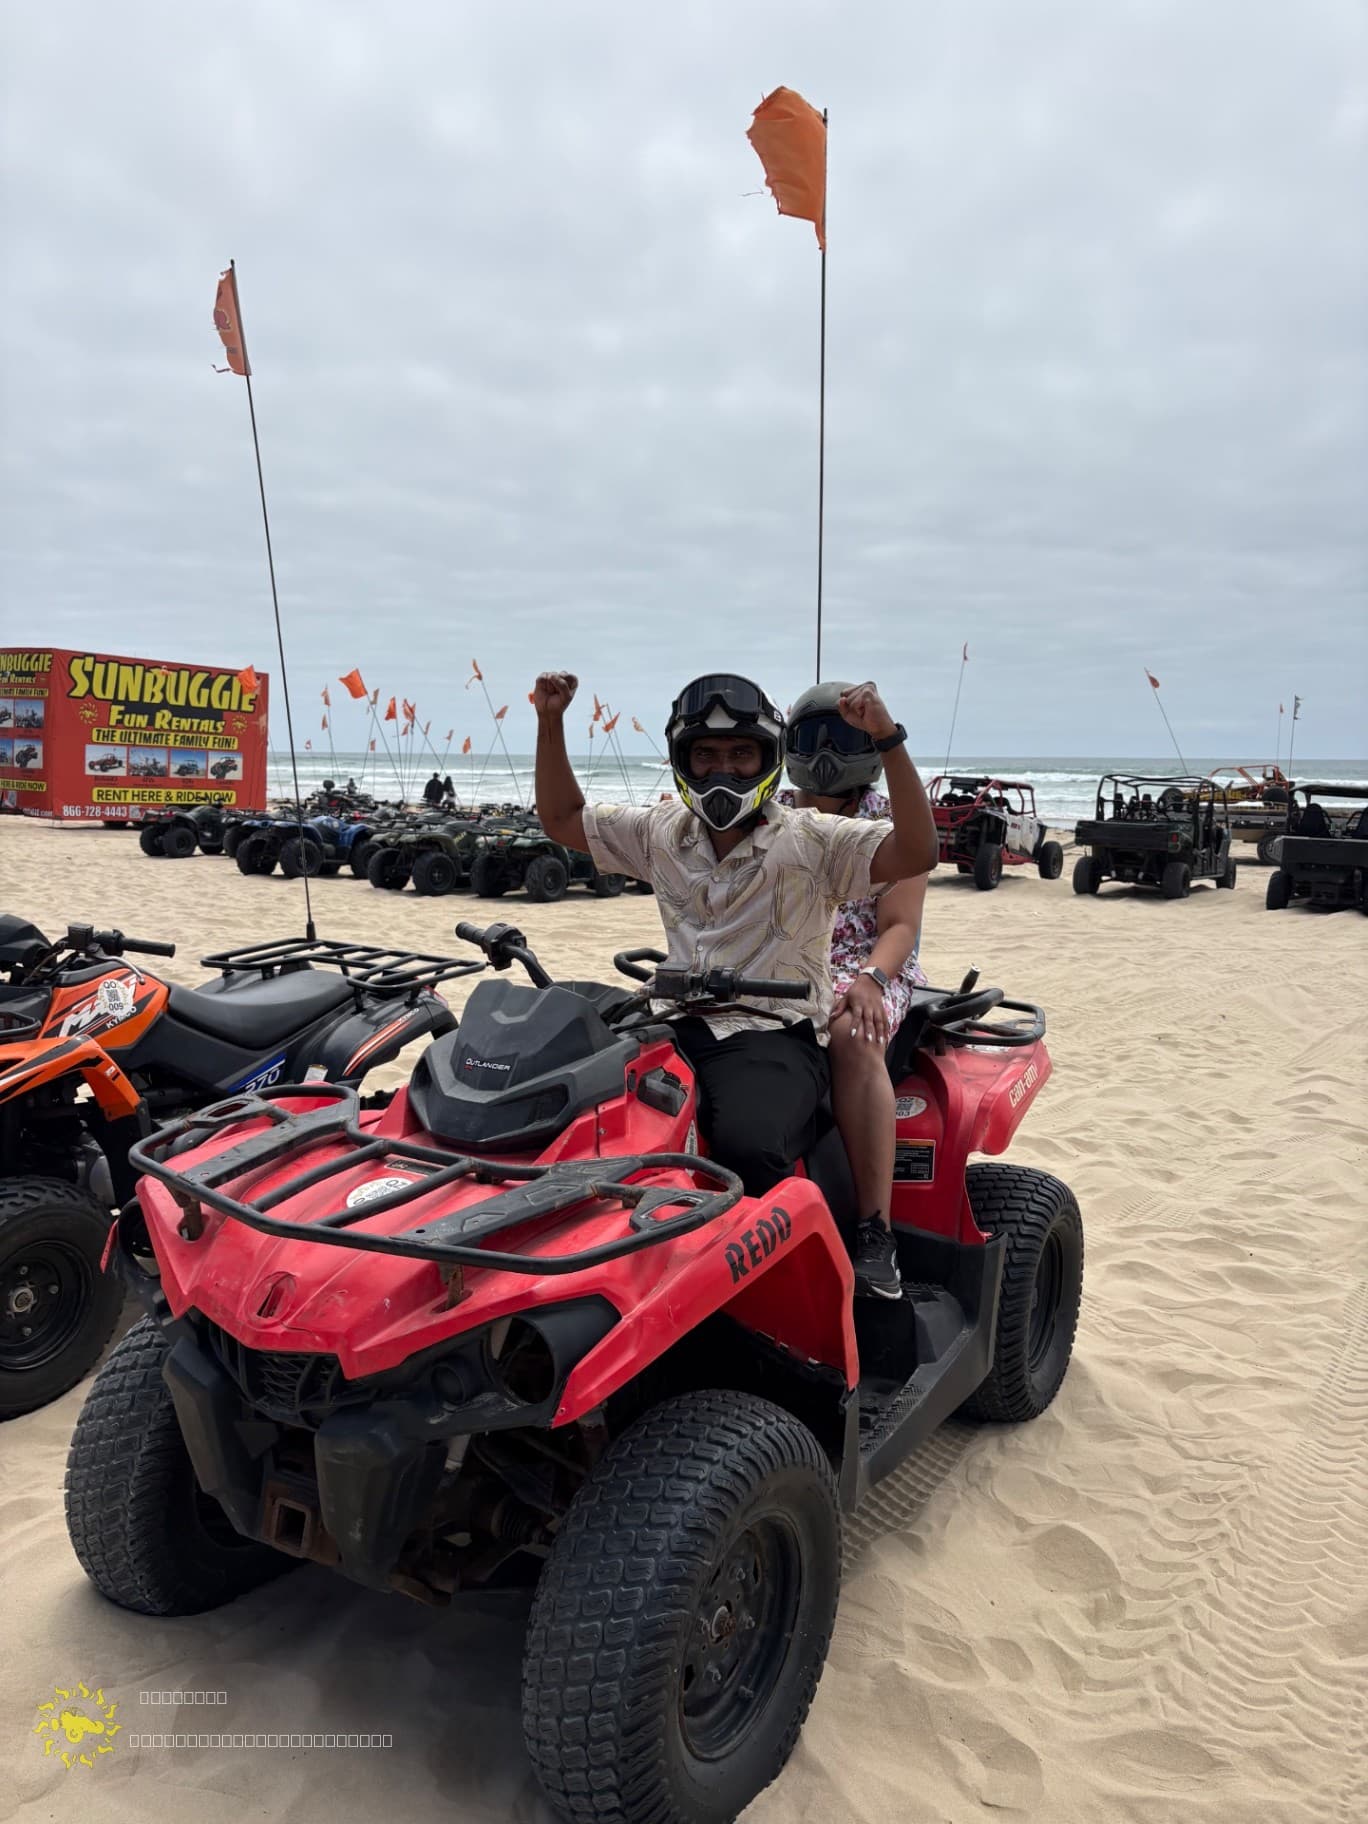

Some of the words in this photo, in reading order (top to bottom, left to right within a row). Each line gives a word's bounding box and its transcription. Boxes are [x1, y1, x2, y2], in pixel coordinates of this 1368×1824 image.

[68, 656, 257, 712] SUNBUGGIE
[95, 729, 118, 742] THE
[119, 731, 171, 746] ULTIMATE
[173, 734, 210, 748] FAMILY
[211, 736, 236, 749] FUN!
[96, 789, 129, 801] RENT
[131, 789, 163, 802] HERE
[164, 791, 175, 802] &
[176, 791, 202, 803] RIDE
[207, 792, 233, 803] NOW
[62, 805, 127, 818] 866-728-4443
[465, 1057, 511, 1071] OUTLANDER
[1008, 1064, 1039, 1108] can-am
